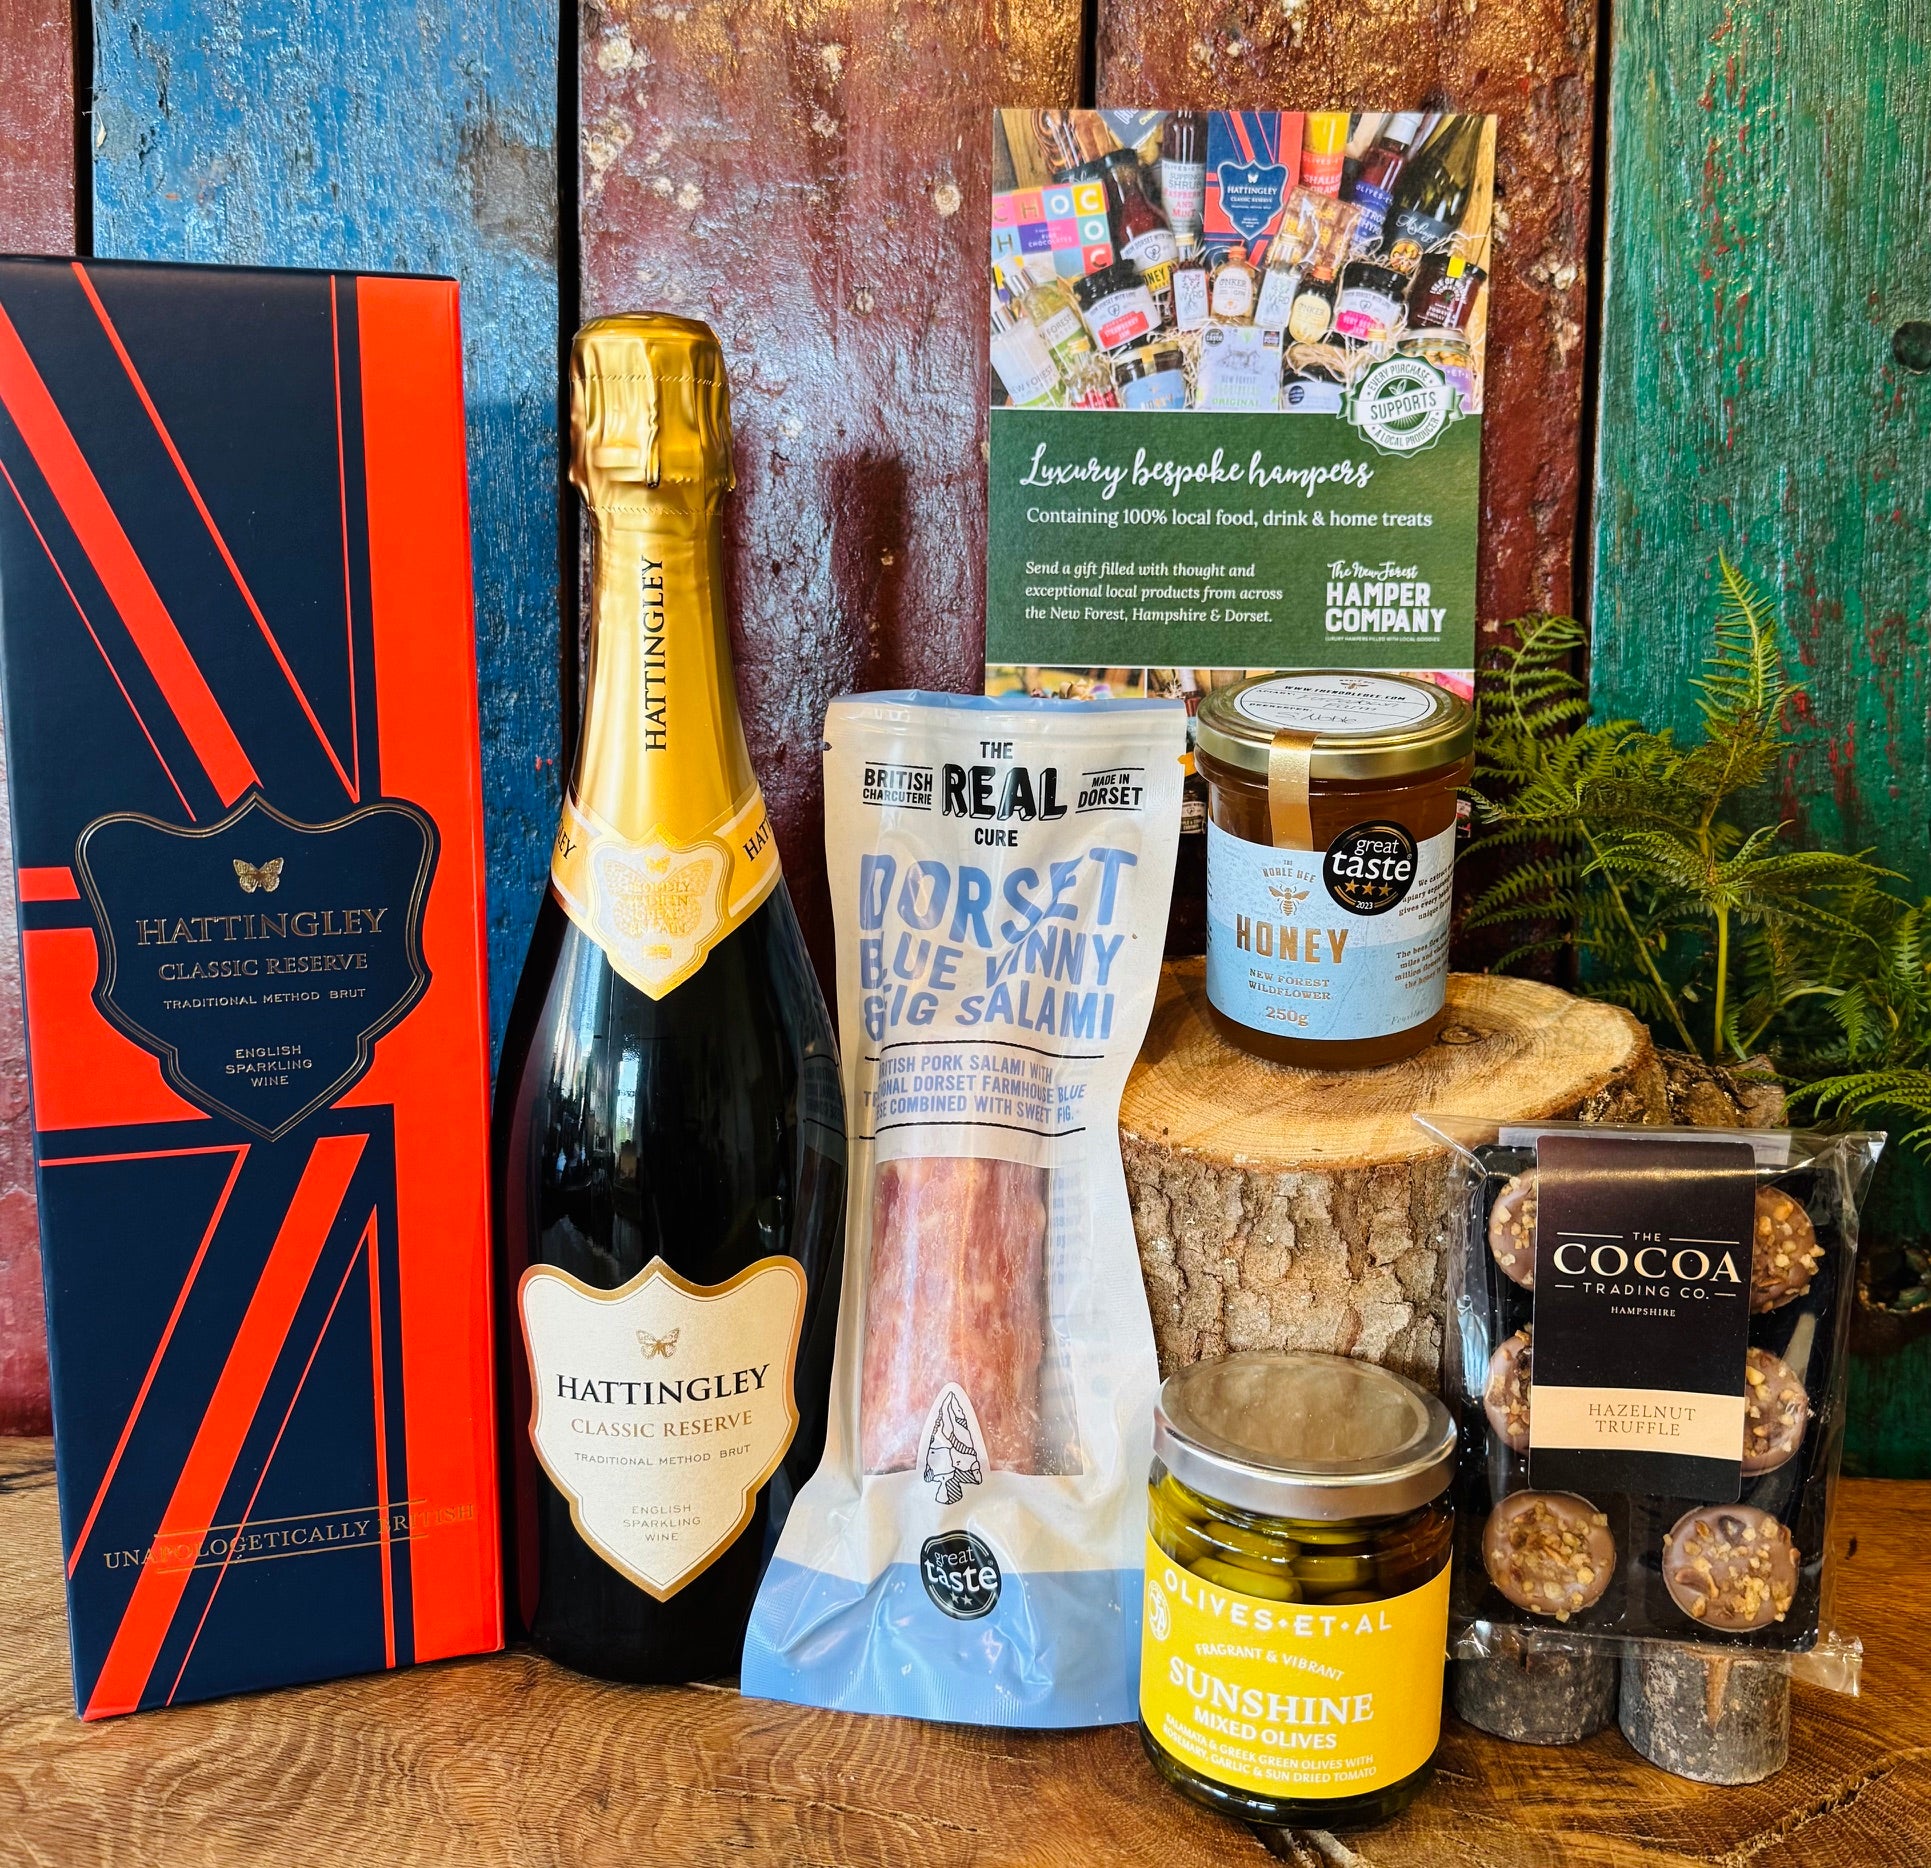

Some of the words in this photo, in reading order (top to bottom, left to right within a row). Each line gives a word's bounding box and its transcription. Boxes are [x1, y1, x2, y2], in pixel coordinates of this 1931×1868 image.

[1227, 185, 1277, 195] HATTINGLEY
[1369, 367, 1390, 391] EVERY
[1391, 363, 1430, 381] PURCHASE
[1370, 391, 1437, 421] SUPPORTS
[1375, 429, 1381, 438] A
[1380, 432, 1404, 447] LOCAL
[1405, 417, 1440, 447] PRODUCER
[1020, 442, 1128, 500] Luxury
[1132, 446, 1245, 497] bespoke
[1248, 449, 1374, 498] hampers
[1026, 506, 1120, 529] Containing
[1122, 508, 1168, 526] 100%
[1171, 508, 1211, 526] local
[1215, 509, 1259, 529] food,
[1262, 510, 1308, 528] drink
[1311, 511, 1326, 526] &
[1329, 510, 1378, 528] home
[1382, 512, 1433, 528] treats
[1025, 561, 1060, 575] Send
[1062, 565, 1072, 575] a
[1073, 562, 1098, 579] gift
[1098, 562, 1136, 579] filled
[1137, 563, 1169, 577] with
[1172, 563, 1226, 581] thought
[1228, 564, 1256, 578] and
[1327, 560, 1352, 580] The
[1352, 561, 1380, 579] New
[1377, 561, 1418, 582] Forest
[1025, 584, 1103, 601] exceptional
[1104, 584, 1138, 599] local
[1140, 585, 1201, 602] products
[1200, 586, 1236, 603] from
[1239, 589, 1284, 600] across
[1326, 581, 1431, 607] HAMPER
[1025, 606, 1047, 620] the
[1049, 607, 1081, 620] New
[1084, 607, 1129, 622] Forest,
[1132, 608, 1208, 625] Hampshire
[1210, 609, 1222, 622] &
[1224, 609, 1273, 623] Dorset.
[1325, 607, 1447, 634] COMPANY
[642, 553, 667, 753] HATTINGLEY
[980, 741, 1013, 760] THE
[864, 768, 933, 793] BRITISH
[1091, 774, 1115, 787] MADE
[1117, 773, 1130, 785] IN
[862, 788, 932, 806] CHARCUTERIE
[942, 763, 1068, 822] REAL
[1077, 786, 1143, 809] DORSET
[974, 827, 1018, 847] CURE
[1356, 839, 1399, 856] great
[1262, 867, 1293, 878] NOBLE
[1296, 870, 1317, 883] BEE
[1331, 850, 1411, 882] taste
[1418, 878, 1429, 888] We
[859, 848, 1138, 949] DORSET
[1355, 900, 1374, 910] 2023
[1399, 904, 1419, 917] gives
[1420, 896, 1437, 911] every
[1402, 891, 1426, 905] apiary
[1418, 907, 1439, 921] unique
[135, 906, 388, 946] HATTINGLEY
[1236, 913, 1350, 964] HONEY
[1396, 949, 1412, 960] The
[1412, 944, 1429, 956] bees
[1400, 958, 1421, 970] miles
[1421, 951, 1433, 963] and
[158, 959, 259, 982] CLASSIC
[266, 953, 369, 976] RESERVE
[1249, 968, 1274, 982] NEW
[1278, 976, 1330, 988] FOREST
[1394, 968, 1422, 981] million
[1248, 980, 1331, 1000] WILDFLOWER
[1405, 979, 1417, 990] the
[163, 995, 257, 1011] TRADITIONAL
[263, 990, 321, 1005] METHOD
[329, 988, 366, 999] BRUT
[955, 979, 1116, 1040] SALAMI
[1265, 1006, 1310, 1027] 250g
[235, 1044, 302, 1060] ENGLISH
[225, 1058, 313, 1075] SPARKLING
[921, 1055, 962, 1072] PORK
[969, 1055, 1025, 1077] SALAMI
[1029, 1062, 1054, 1084] WITH
[250, 1074, 290, 1087] WINE
[913, 1075, 976, 1092] DORSET
[982, 1076, 1054, 1105] FARMHOUSE
[1057, 1083, 1088, 1103] BLUE
[890, 1095, 968, 1114] COMBINED
[973, 1095, 1012, 1116] WITH
[1016, 1103, 1051, 1125] SWEET
[1057, 1104, 1074, 1124] FIG.
[1633, 1232, 1661, 1242] THE
[1553, 1243, 1742, 1283] COCOA
[1583, 1282, 1670, 1297] TRADING
[1680, 1287, 1710, 1300] CO.
[1611, 1305, 1676, 1317] HAMPSHIRE
[556, 1363, 770, 1405] HATTINGLEY
[1588, 1403, 1696, 1421] HAZELNUT
[570, 1418, 654, 1438] CLASSIC
[663, 1410, 753, 1437] RESERVE
[1595, 1420, 1680, 1437] TRUFFLE
[574, 1452, 653, 1466] TRADITIONAL
[658, 1452, 711, 1466] METHOD
[719, 1444, 751, 1459] BRUT
[632, 1504, 692, 1515] ENGLISH
[623, 1515, 701, 1528] SPARKLING
[103, 1519, 370, 1570] UNAPOLOGETICALLY
[377, 1503, 474, 1536] BRITISH
[645, 1532, 679, 1542] WINE
[934, 1546, 976, 1568] great
[924, 1558, 999, 1593] taste
[1195, 1643, 1263, 1659] FRAGRANT
[1265, 1650, 1278, 1664] &
[1281, 1655, 1345, 1682] VIBRANT
[1169, 1656, 1374, 1726] SUNSHINE
[1194, 1705, 1257, 1741] MIXED
[1260, 1728, 1338, 1749] OLIVES
[1165, 1712, 1208, 1748] KALAMATA
[1208, 1739, 1218, 1749] &
[1219, 1744, 1258, 1763] GREEK
[1258, 1754, 1300, 1769] GREEN
[1301, 1757, 1343, 1770] OLIVES
[1345, 1754, 1374, 1769] WITH
[1163, 1723, 1209, 1763] ROSEMARY,
[1210, 1753, 1251, 1775] GARLIC
[1252, 1766, 1263, 1778] &
[1265, 1767, 1291, 1782] SUN
[1293, 1772, 1331, 1783] DRIED
[1333, 1766, 1377, 1783] TOMATO
